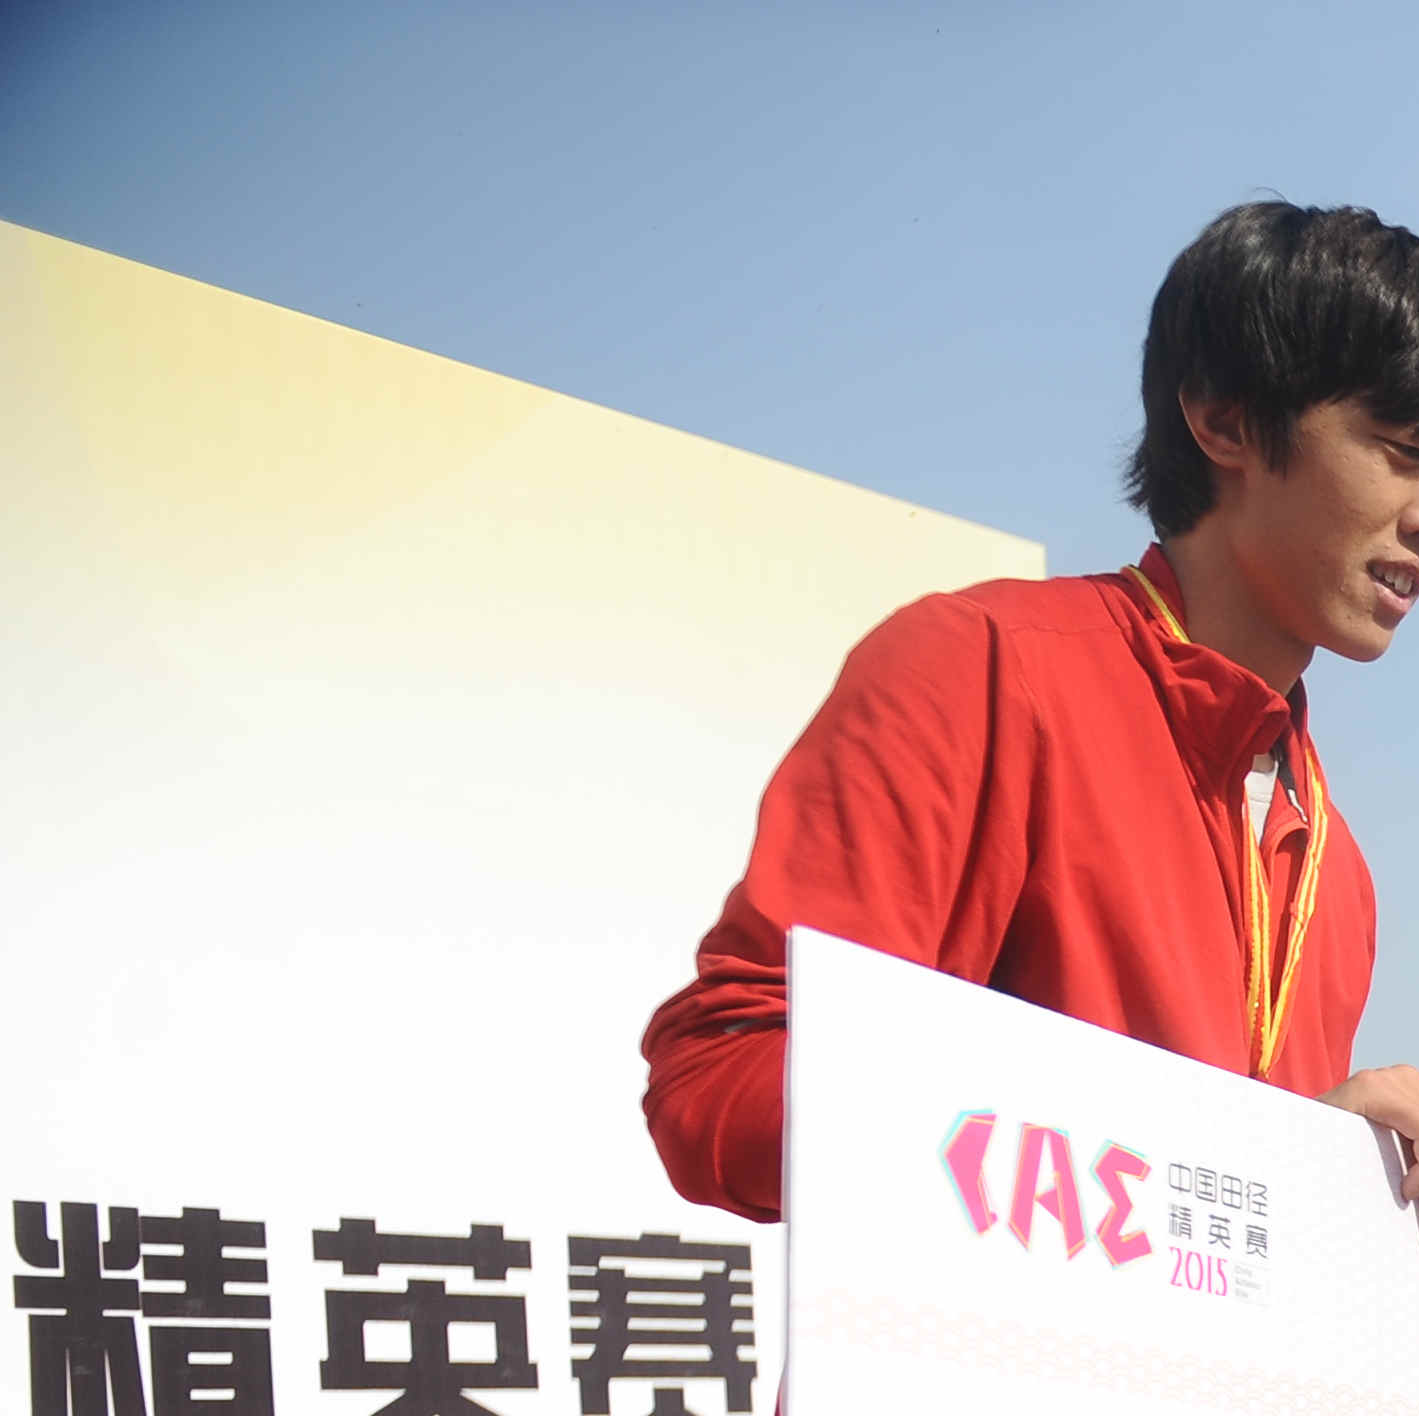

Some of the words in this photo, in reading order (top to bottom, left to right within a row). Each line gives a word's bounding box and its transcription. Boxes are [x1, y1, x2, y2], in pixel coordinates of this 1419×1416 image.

[1169, 1162, 1268, 1218] 中国田径
[1169, 1203, 1268, 1259] 精英赛
[1169, 1246, 1228, 1297] 2015
